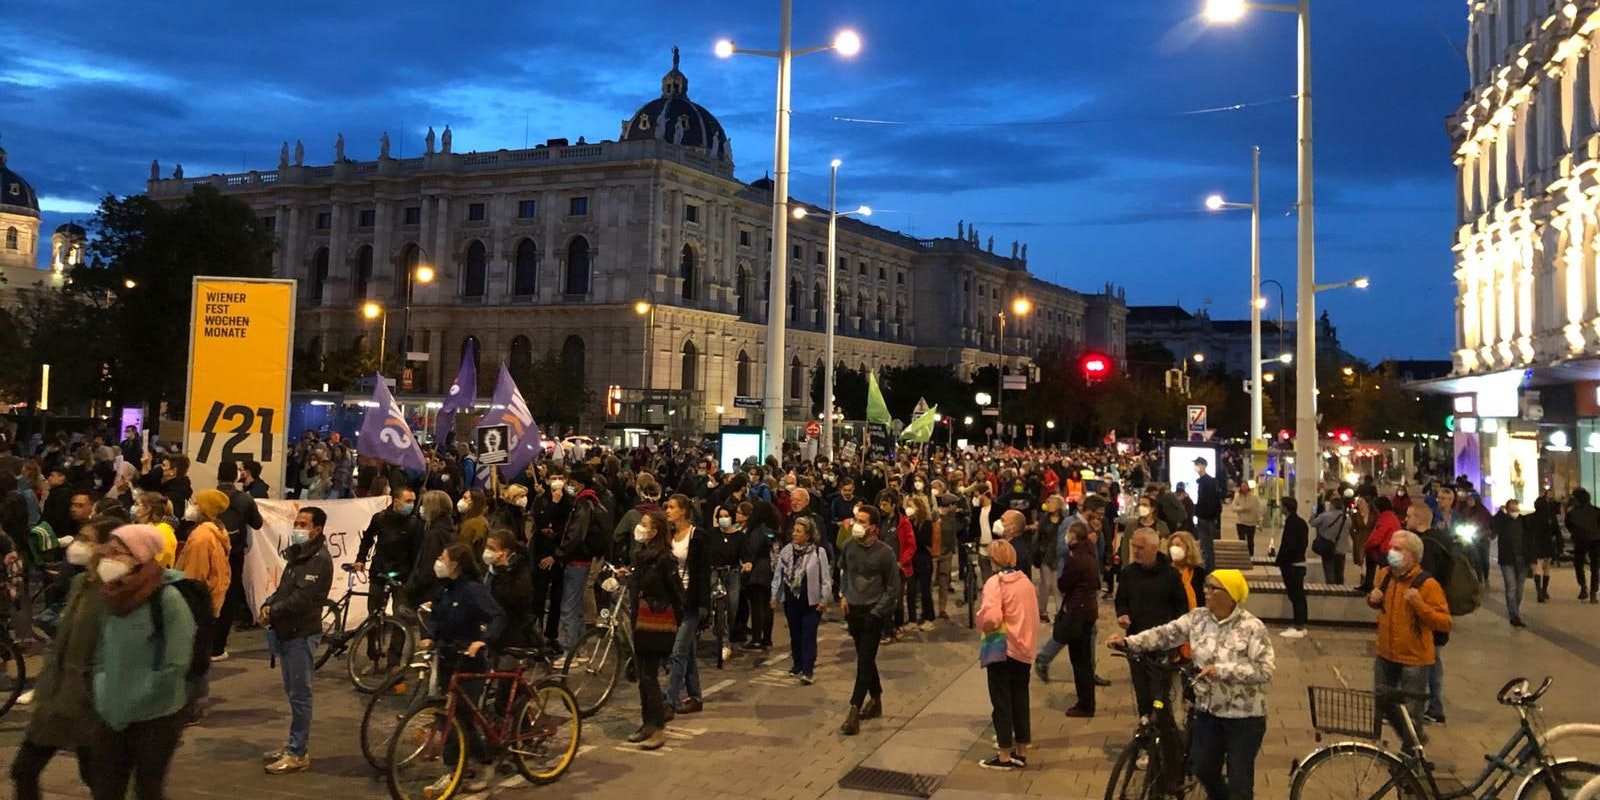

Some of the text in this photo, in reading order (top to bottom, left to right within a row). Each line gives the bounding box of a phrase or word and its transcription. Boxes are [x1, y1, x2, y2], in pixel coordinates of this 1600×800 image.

[206, 292, 246, 303] WIENER
[205, 304, 230, 314] FEST
[205, 315, 249, 326] WOCHEN
[204, 327, 247, 338] MONATE
